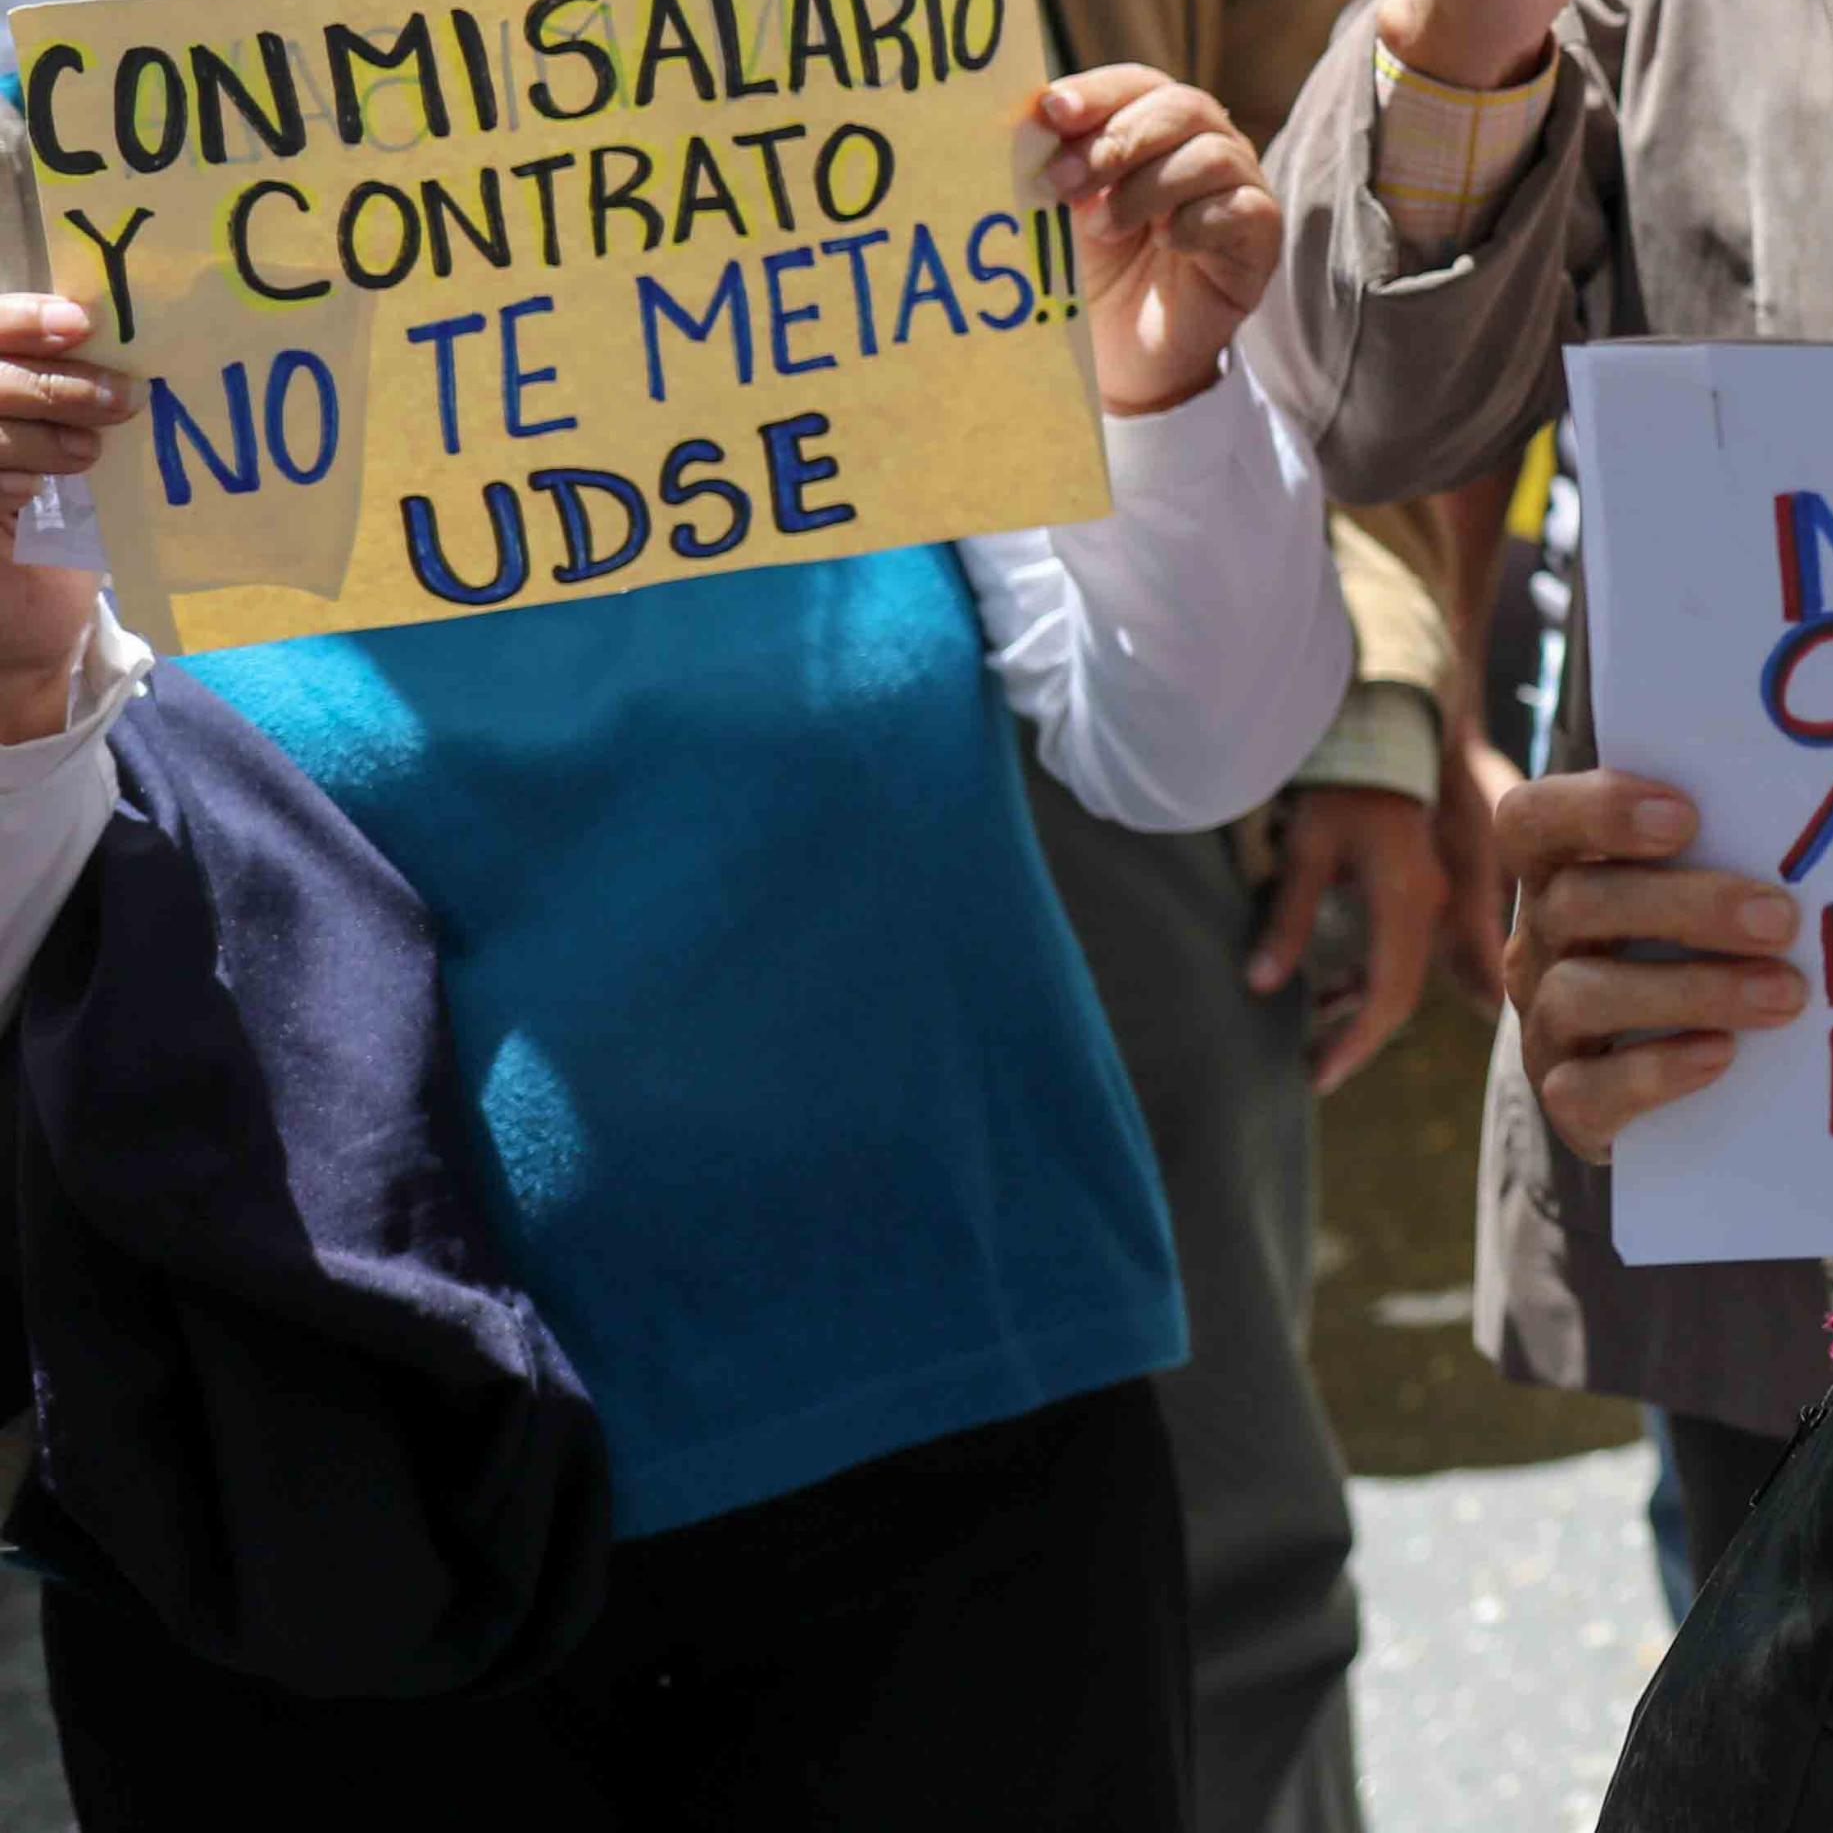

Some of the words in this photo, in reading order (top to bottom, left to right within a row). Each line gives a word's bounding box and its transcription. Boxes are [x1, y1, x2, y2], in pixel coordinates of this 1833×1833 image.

[64, 206, 155, 342] Y
[230, 122, 893, 301] CONTRATO
[150, 349, 339, 506] NO
[408, 296, 577, 454] TE
[636, 202, 1080, 402] METAS!!
[400, 411, 857, 606] UDSE
